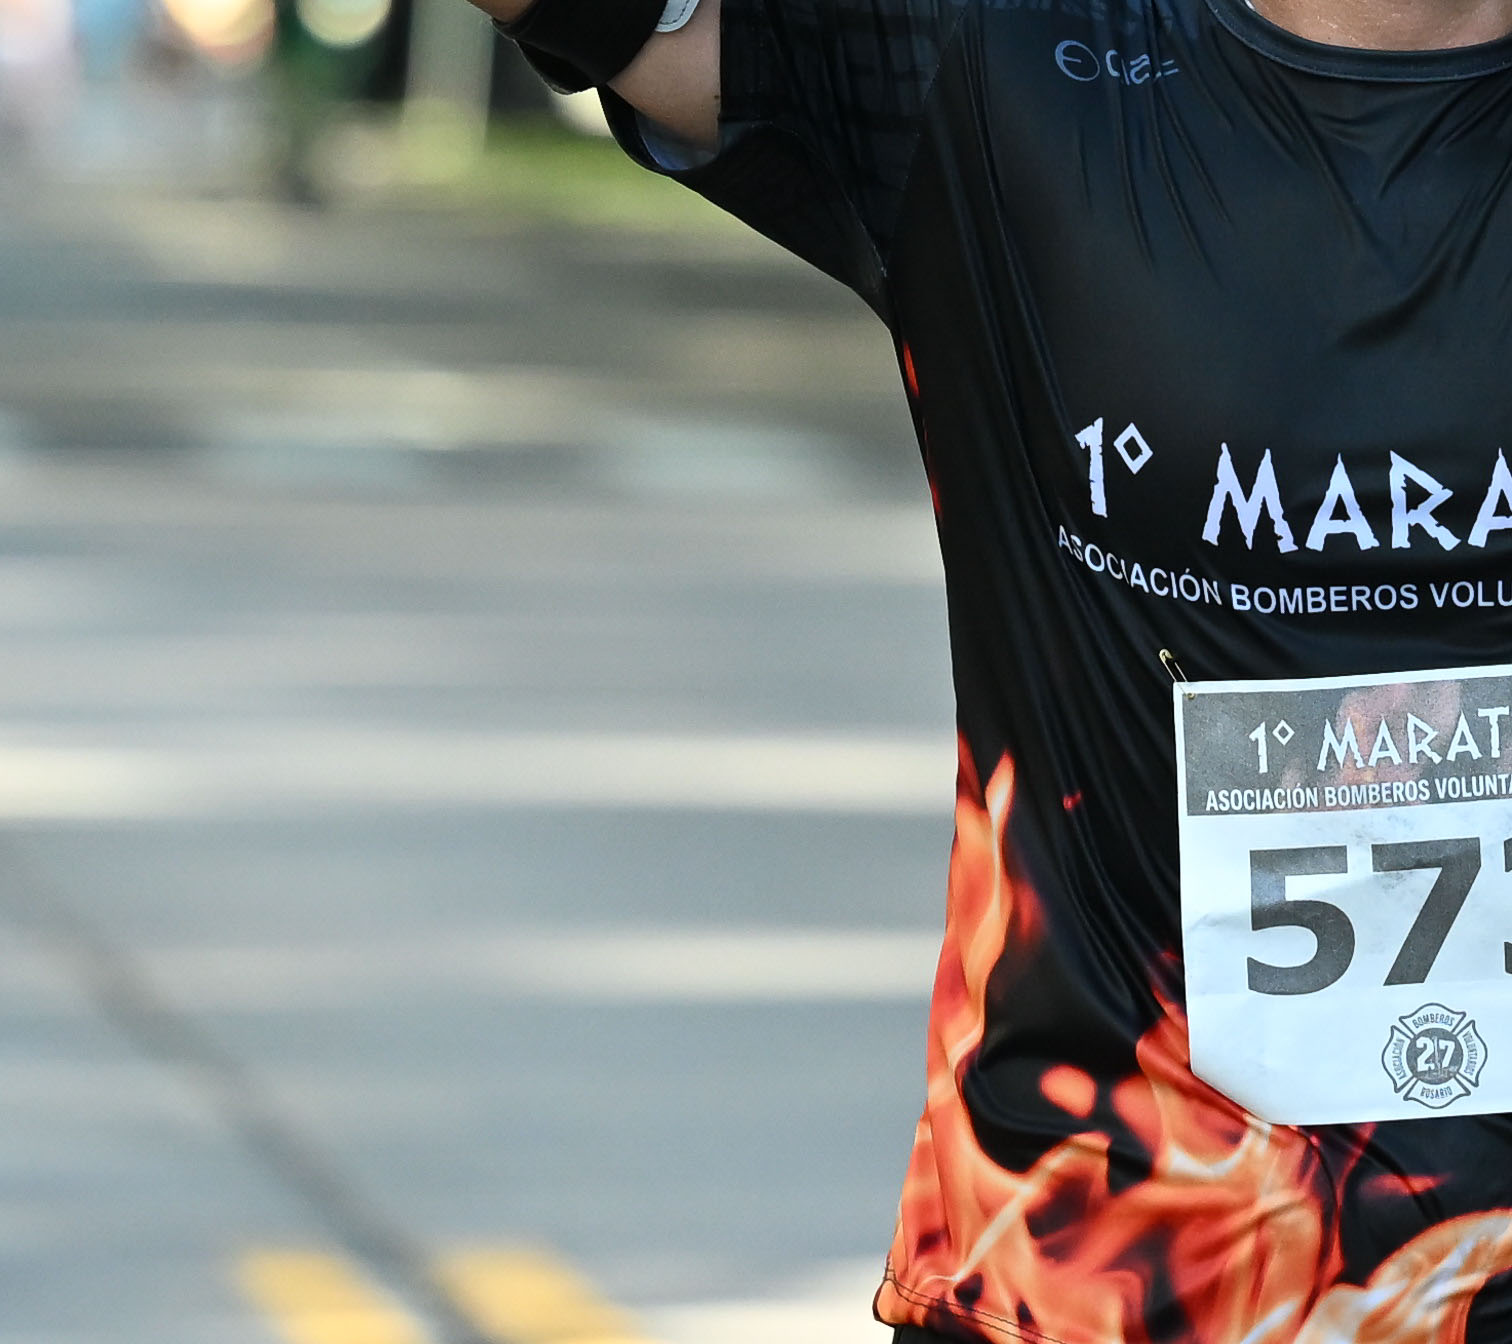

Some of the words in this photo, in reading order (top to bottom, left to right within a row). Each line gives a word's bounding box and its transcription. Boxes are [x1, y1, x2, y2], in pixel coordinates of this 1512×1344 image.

[1058, 524, 1222, 605] ASOCIACIÓN
[1231, 584, 1419, 614] BOMBEROS
[1205, 782, 1319, 812] ASOCIACIÓN
[1324, 778, 1431, 807] BOMBEROS
[1412, 1013, 1455, 1029] BOMBEROS
[1415, 1036, 1456, 1073] 27
[1420, 1086, 1453, 1099] ROSARIO
